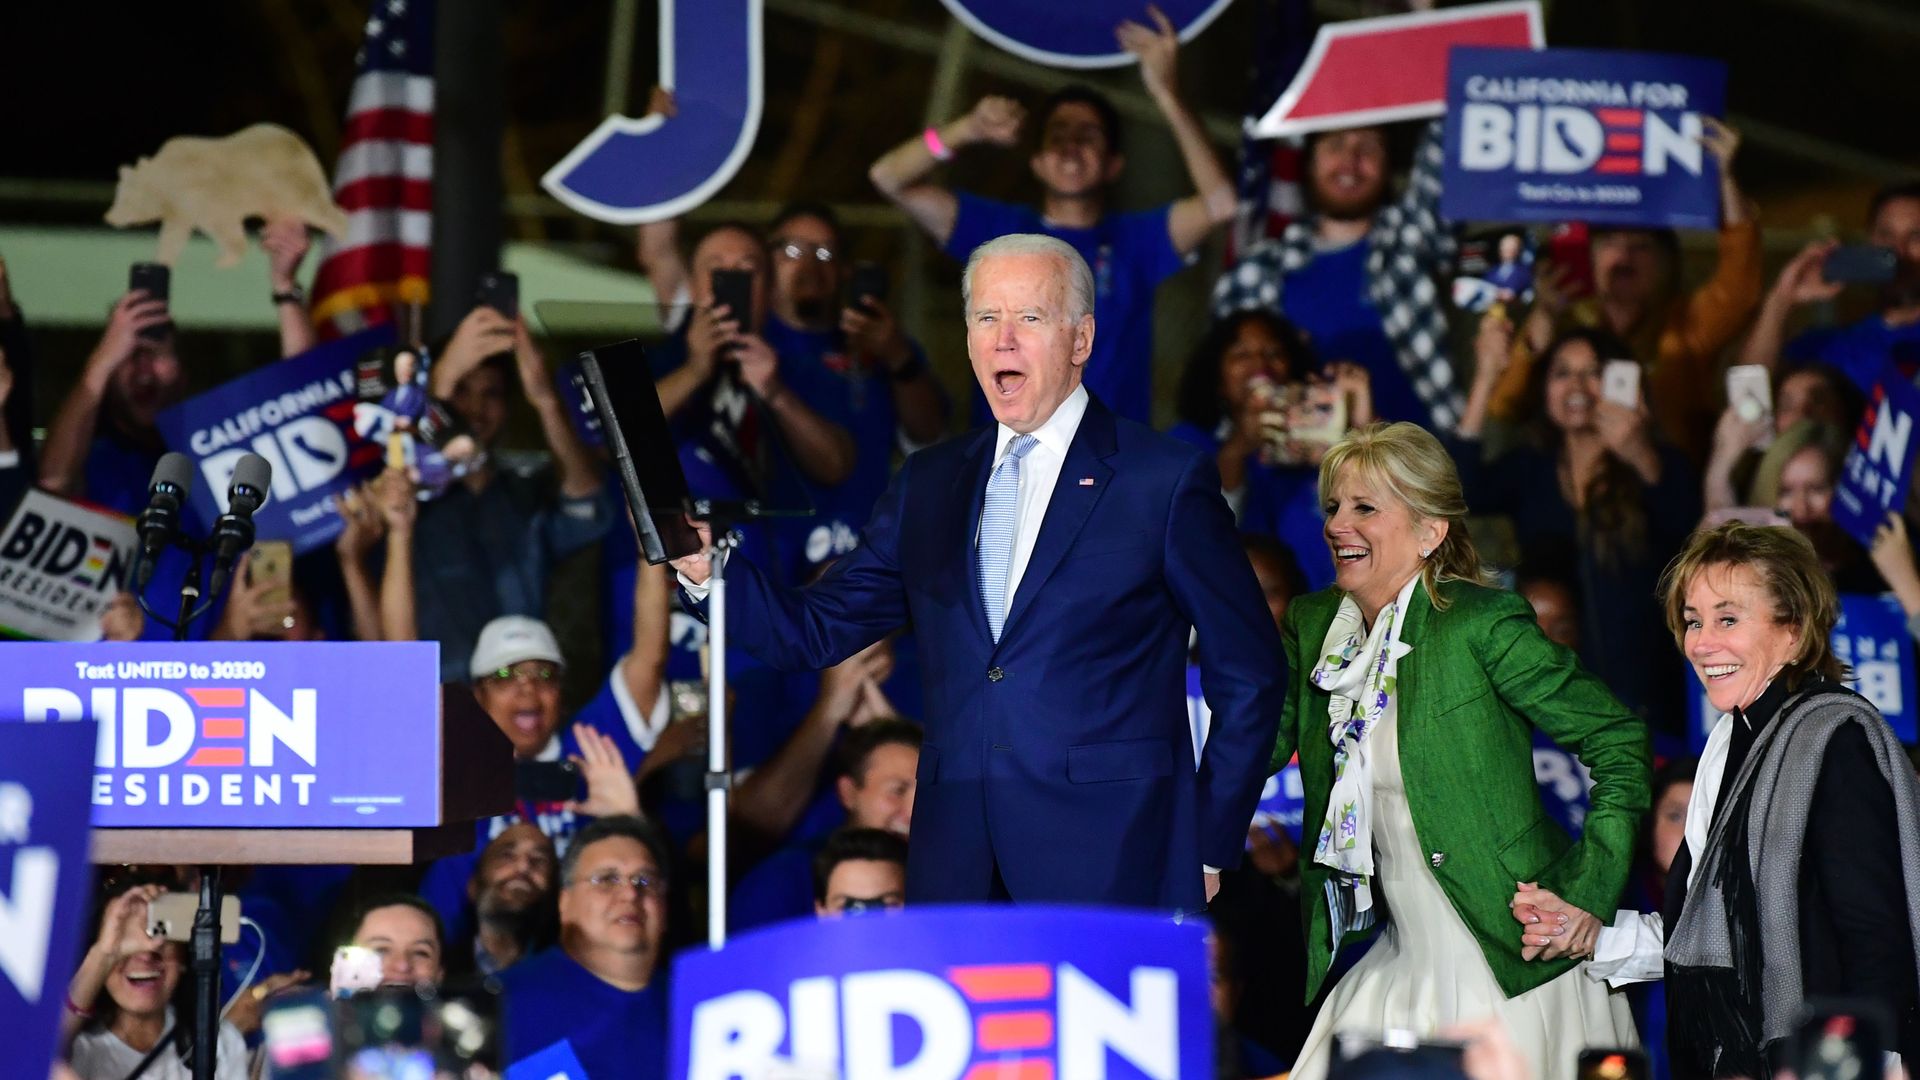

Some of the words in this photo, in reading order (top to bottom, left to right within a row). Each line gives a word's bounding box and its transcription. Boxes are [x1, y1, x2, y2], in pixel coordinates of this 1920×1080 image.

[1465, 75, 1628, 105] CALIFORNIA
[1630, 81, 1689, 108] FOR
[1461, 102, 1702, 177] BIDEN
[190, 377, 343, 455] CALIFORNIA
[2, 511, 134, 593] BIDEN
[75, 661, 115, 680] Text
[117, 661, 188, 680] UNITED
[189, 662, 209, 680] to
[210, 661, 266, 680] 30330
[92, 774, 317, 806] ESIDENT
[687, 962, 1180, 1080] BIDEN
